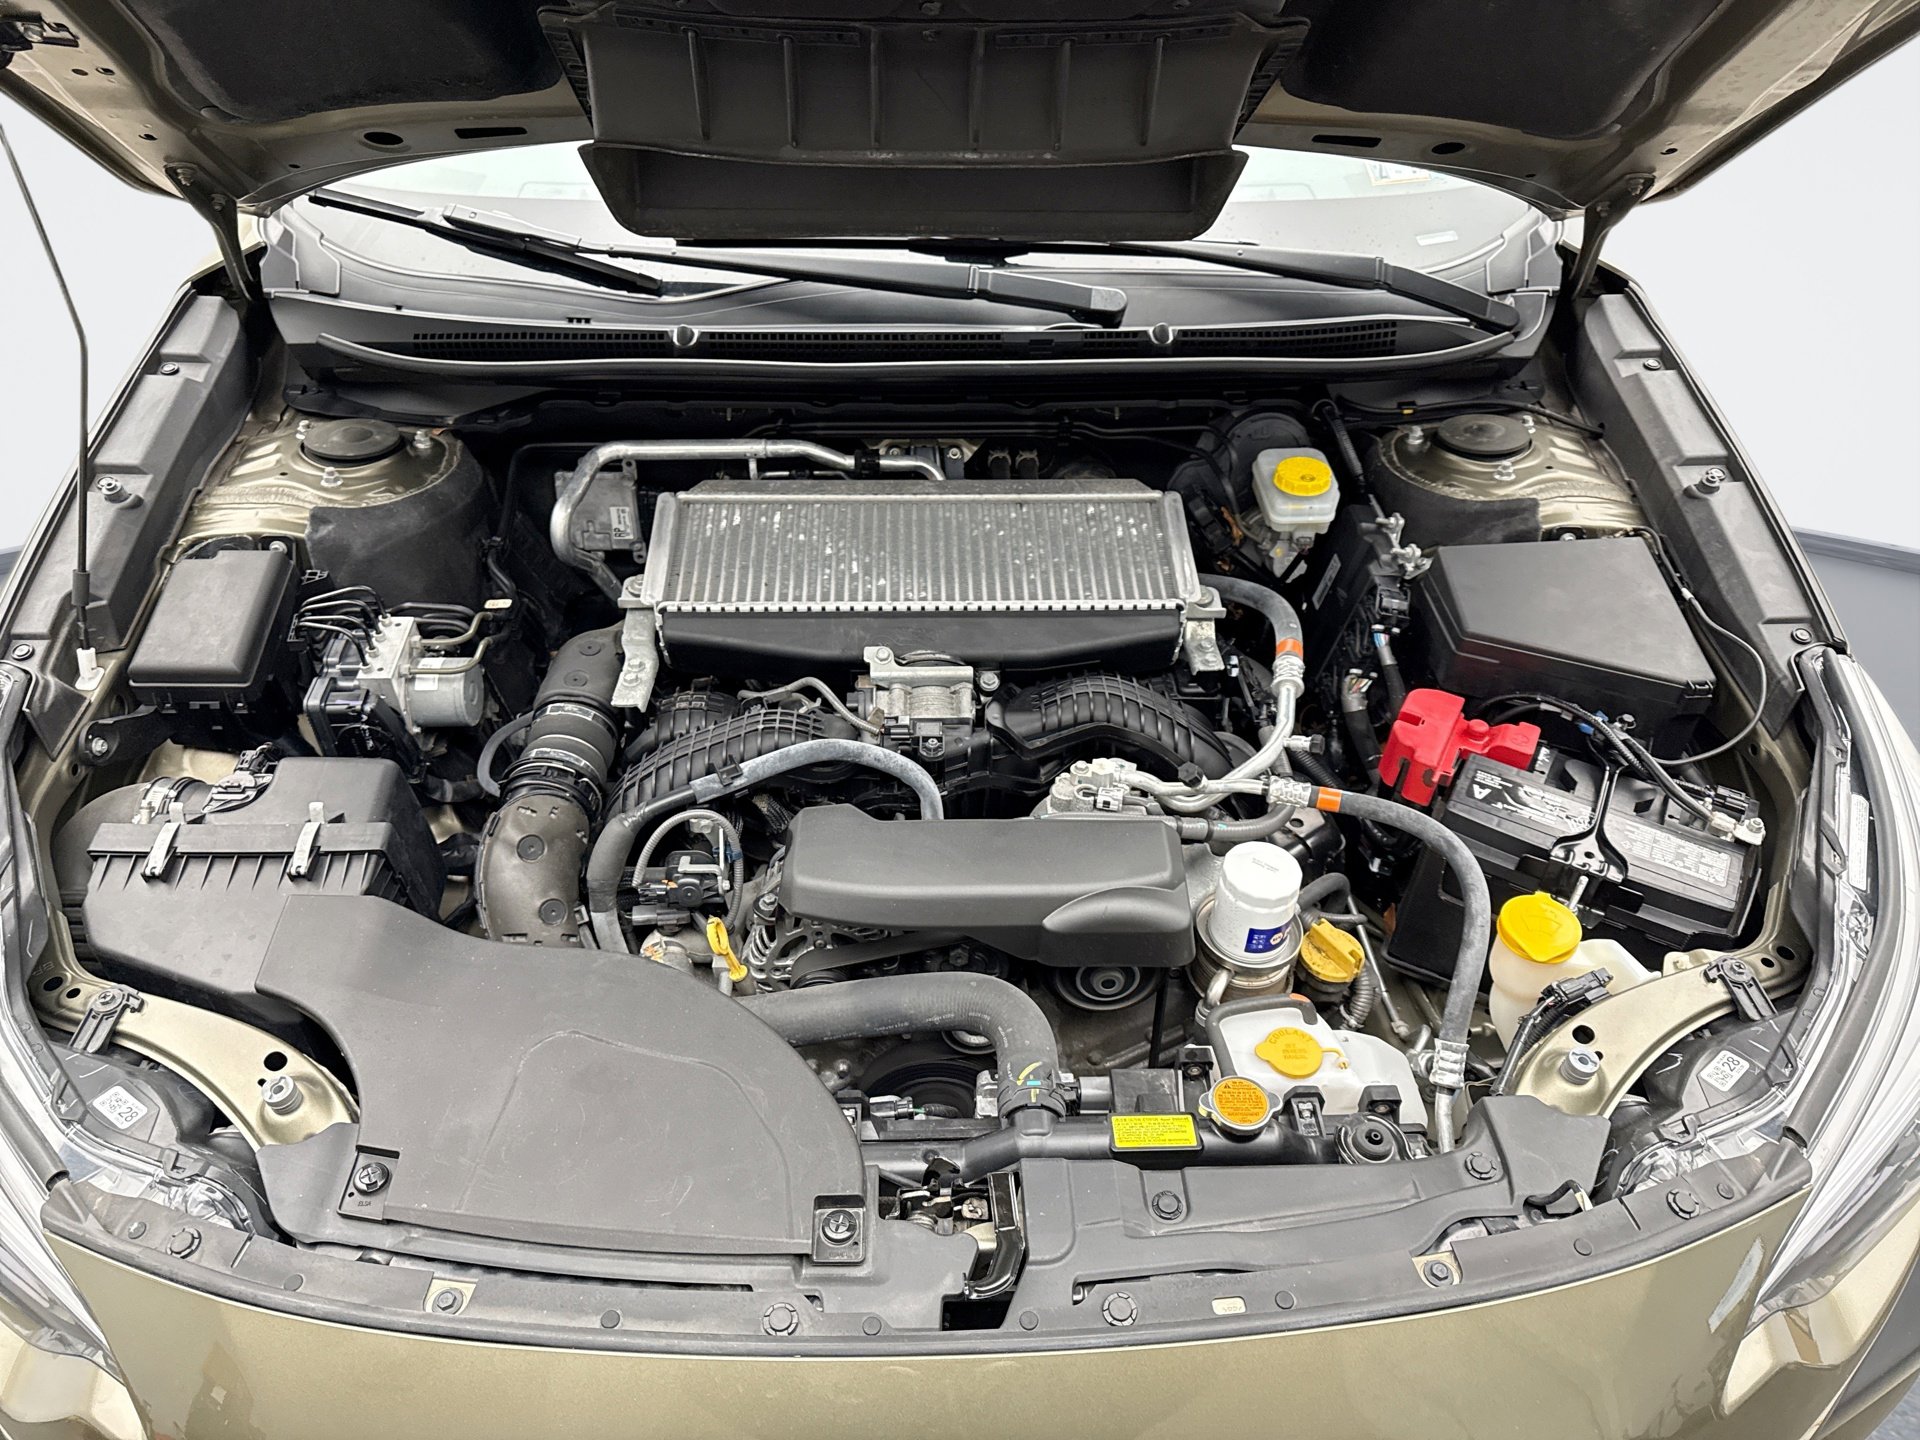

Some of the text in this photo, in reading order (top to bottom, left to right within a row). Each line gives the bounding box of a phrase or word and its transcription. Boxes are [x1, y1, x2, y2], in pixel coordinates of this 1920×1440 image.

[1268, 1028, 1313, 1045] COOLANT
[1721, 1056, 1741, 1072] 28
[118, 1106, 139, 1122] 28
